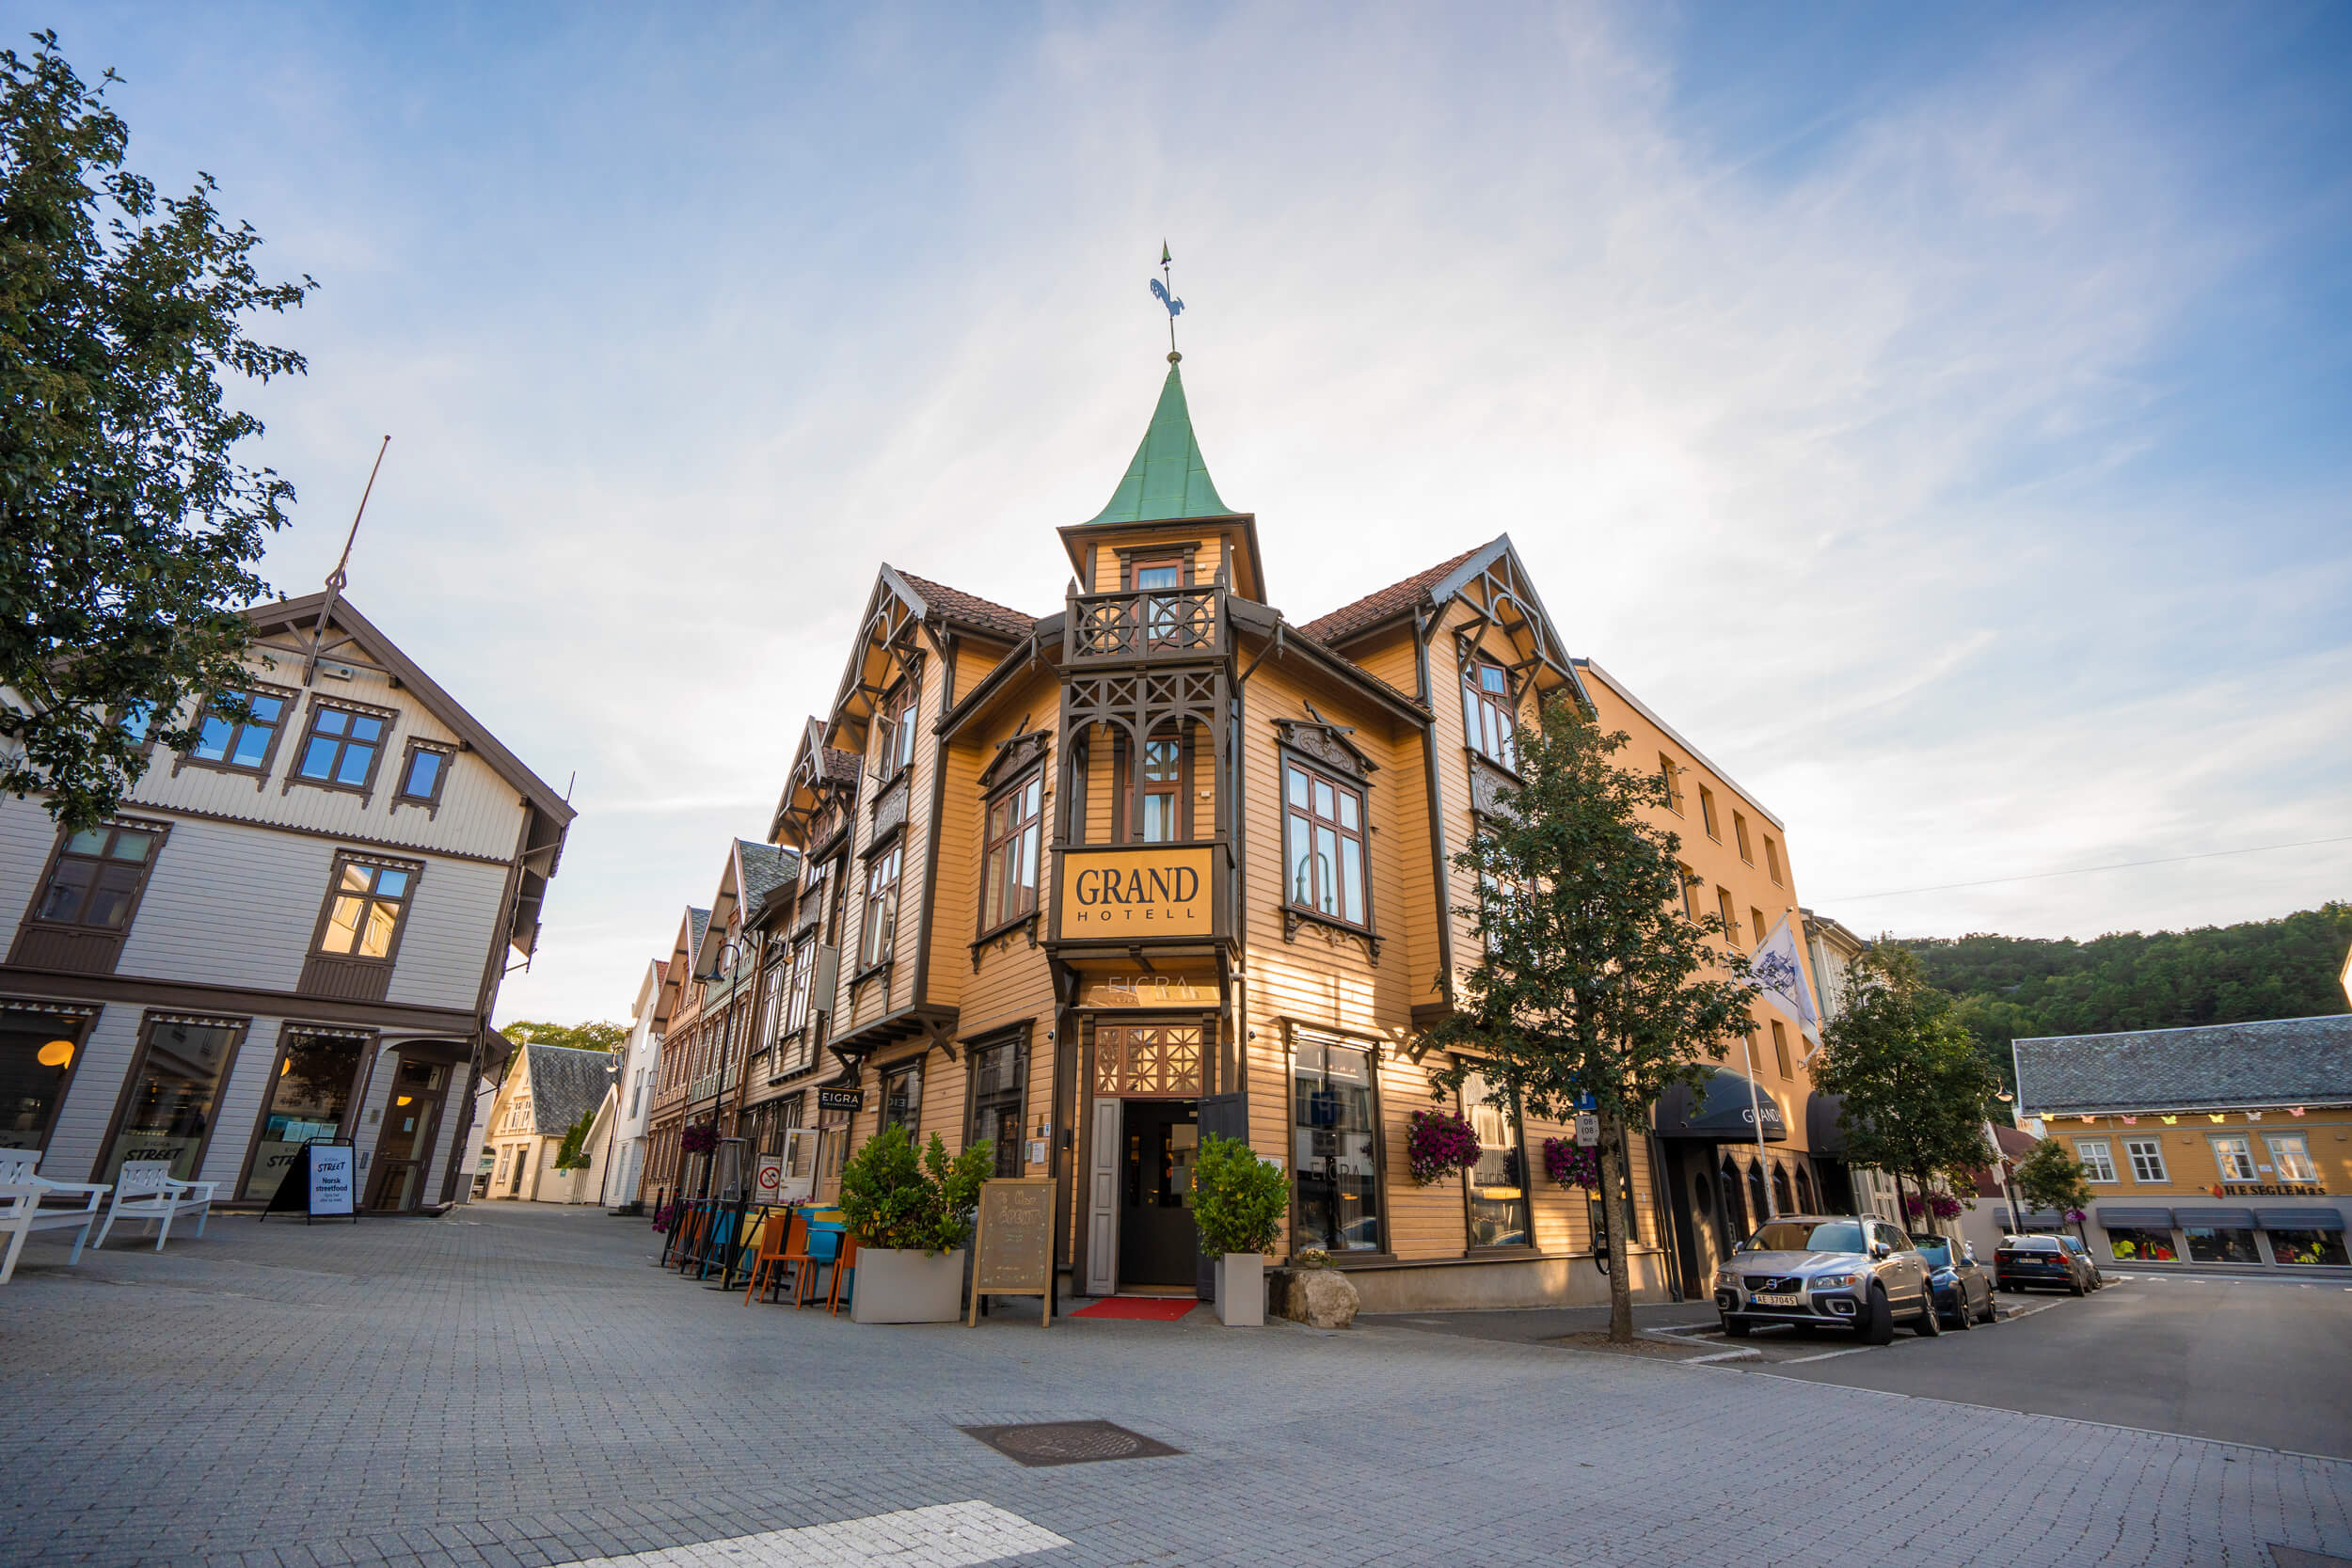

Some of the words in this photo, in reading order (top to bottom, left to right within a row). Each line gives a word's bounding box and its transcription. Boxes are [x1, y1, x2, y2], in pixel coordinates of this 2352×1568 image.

[1076, 866, 1199, 906] GRAND
[1077, 908, 1195, 922] HOTELL
[822, 1092, 858, 1104] EIGRA
[124, 1148, 185, 1162] STREET
[317, 1162, 346, 1173] STREET
[1770, 1296, 1794, 1305] 37045
